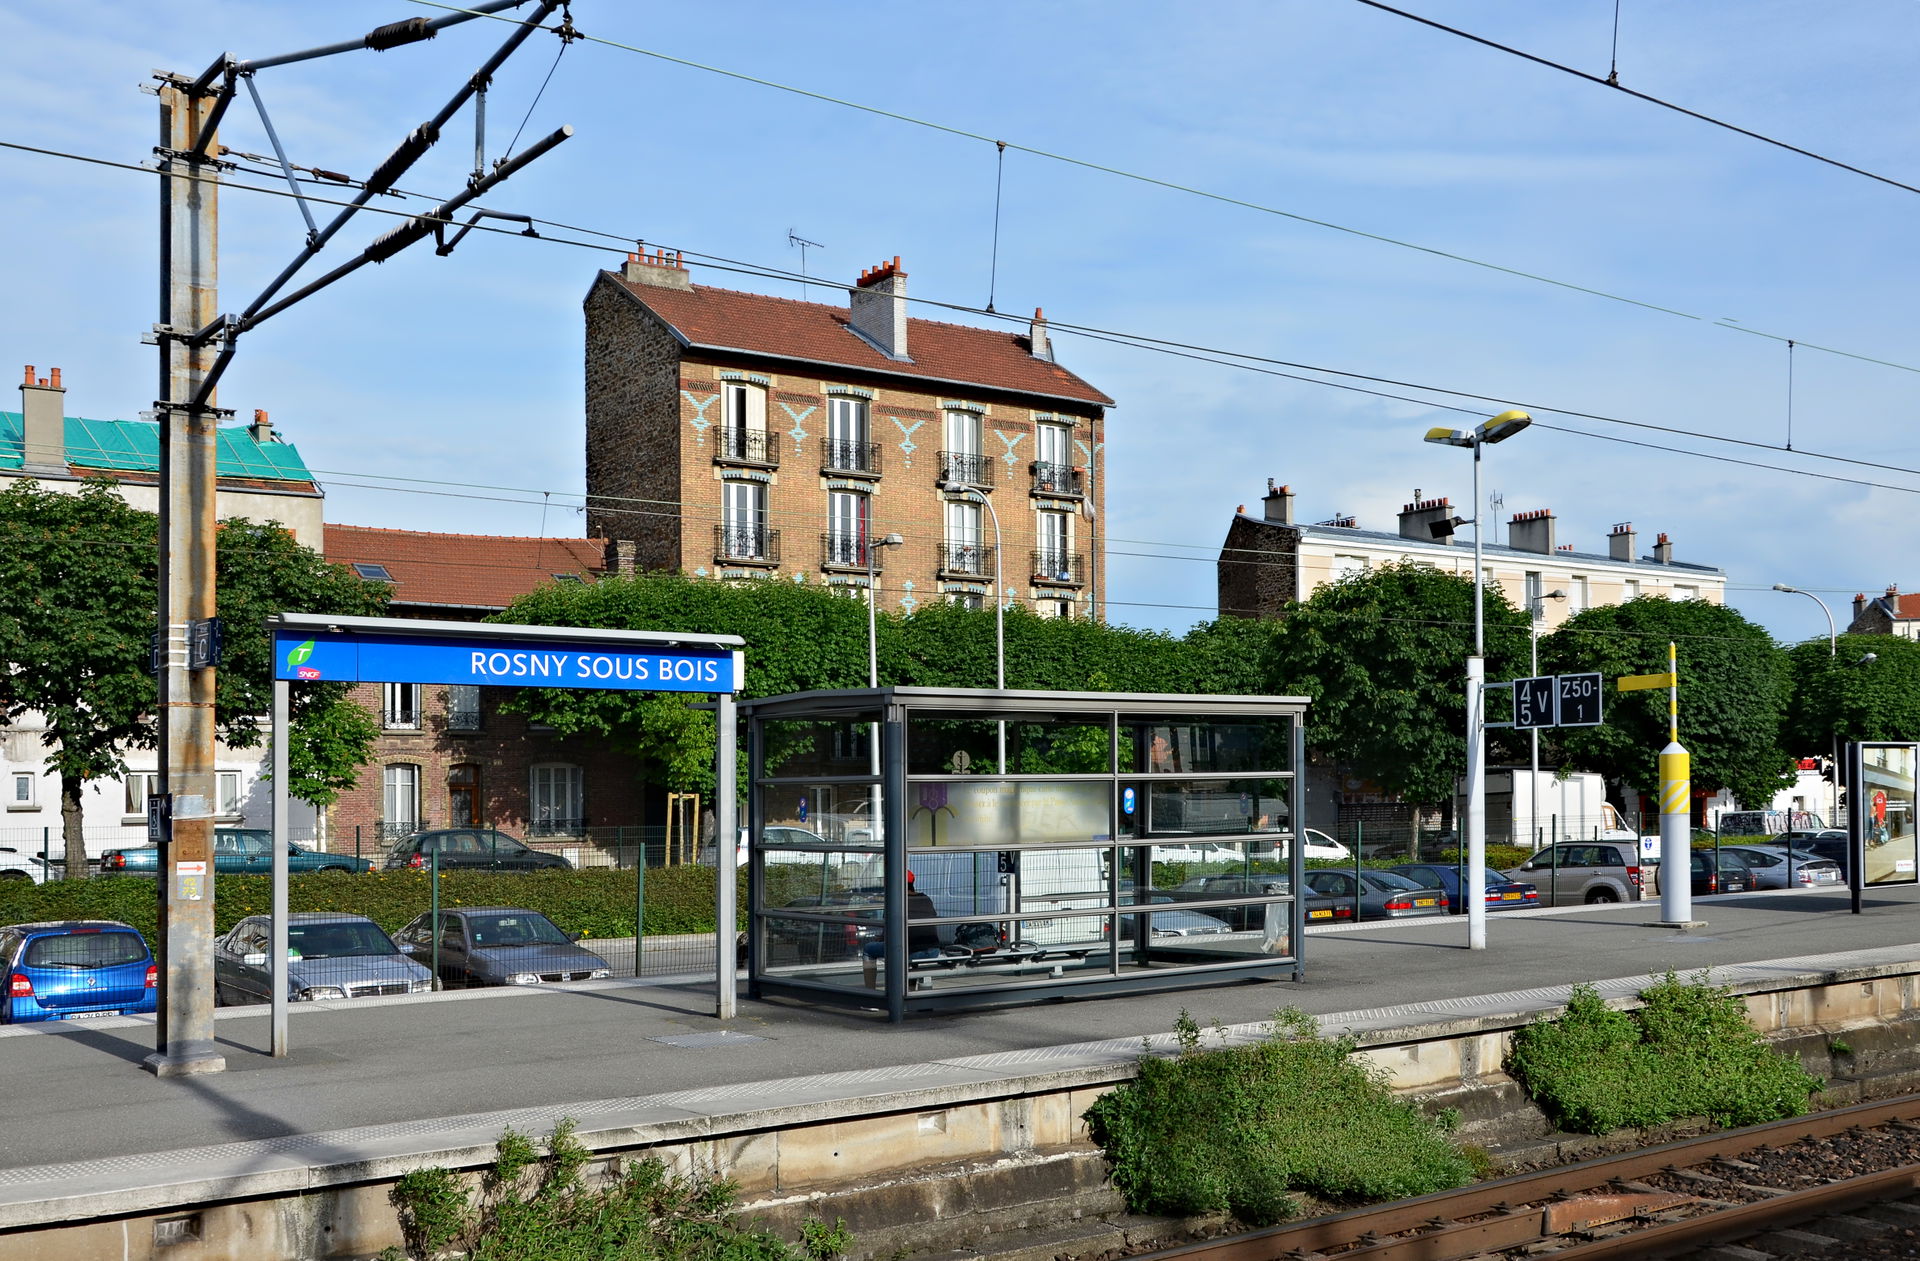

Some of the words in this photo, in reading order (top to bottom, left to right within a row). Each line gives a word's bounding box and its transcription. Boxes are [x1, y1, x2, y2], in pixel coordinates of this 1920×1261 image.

[298, 648, 310, 661] T
[471, 651, 568, 677] ROSNY
[577, 655, 649, 680] SOUS
[659, 659, 718, 682] BOIS
[1520, 681, 1531, 702] 4
[1537, 691, 1548, 712] V
[1521, 704, 1531, 725] 5
[1577, 704, 1583, 719] 1
[1000, 856, 1007, 872] 5
